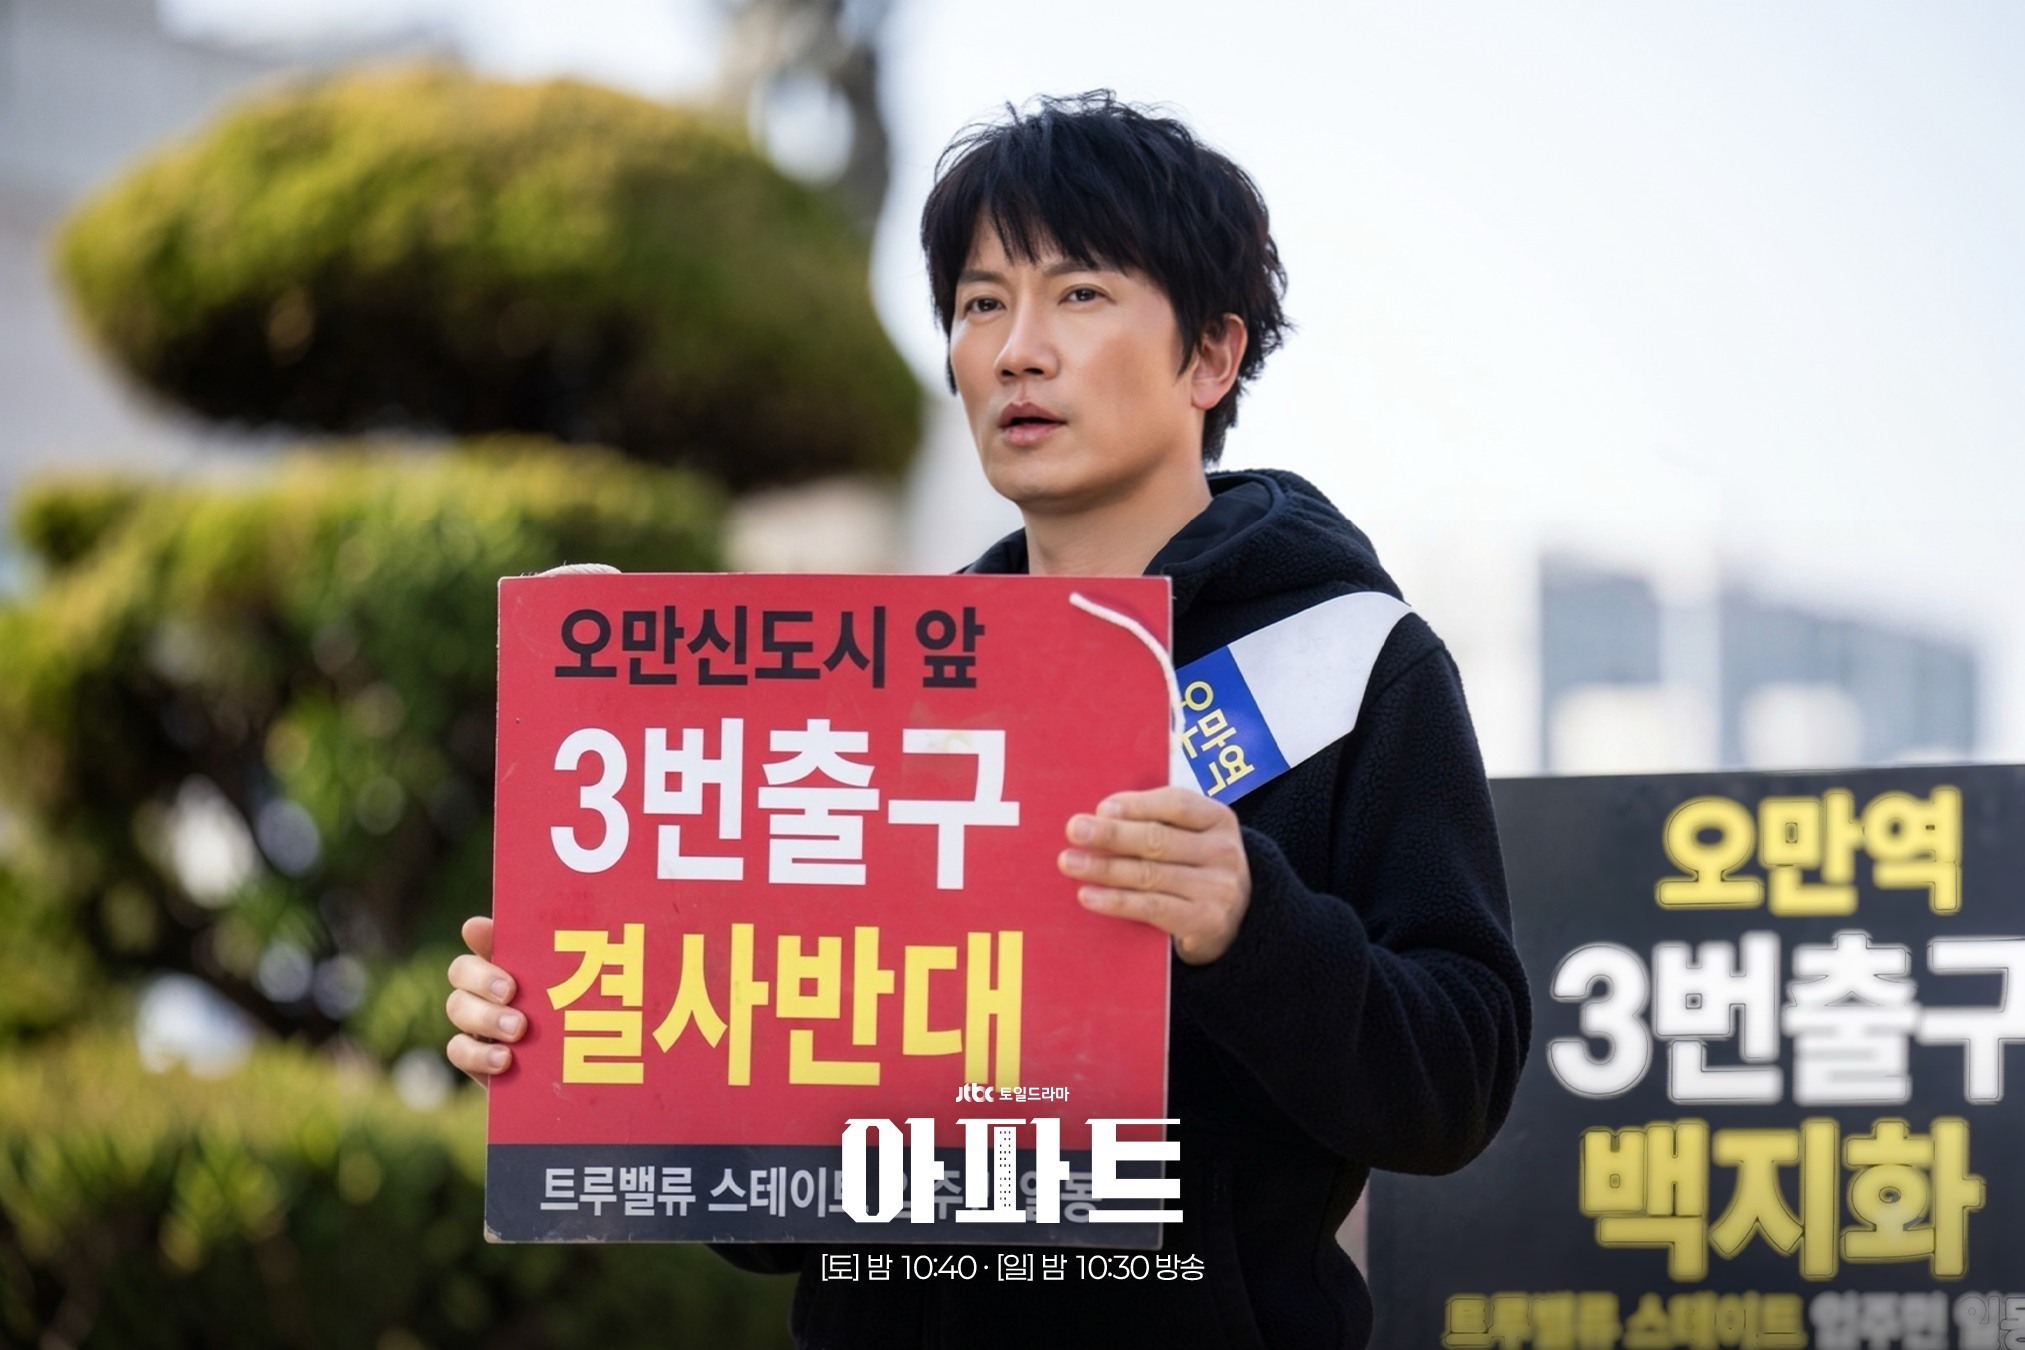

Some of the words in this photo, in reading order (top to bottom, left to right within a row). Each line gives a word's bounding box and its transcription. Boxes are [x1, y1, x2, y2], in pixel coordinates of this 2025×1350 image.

[554, 605, 886, 689] 오만신도시
[915, 606, 985, 688] 앞
[550, 717, 1020, 889] 3번출구
[1655, 785, 1963, 916] 오만역
[546, 922, 1023, 1093] 결사반대
[1547, 930, 2025, 1104] 3번출구
[540, 1166, 696, 1216] 트루밸류
[1579, 1117, 1986, 1281] 백지화
